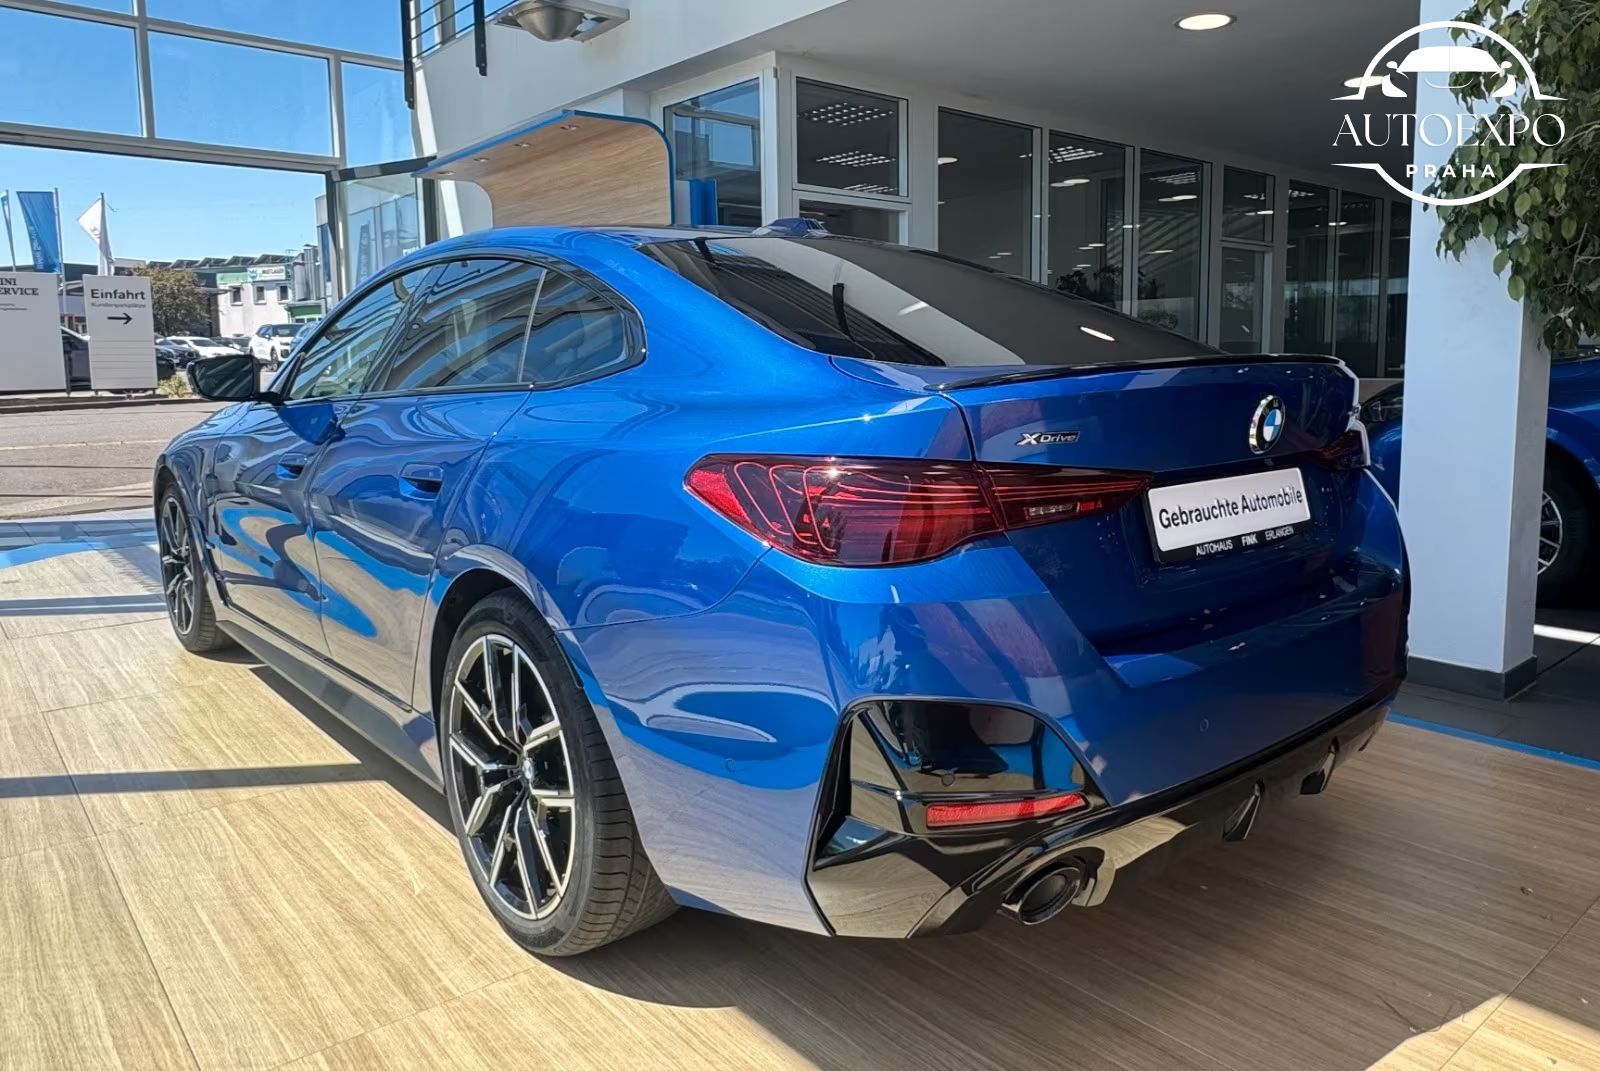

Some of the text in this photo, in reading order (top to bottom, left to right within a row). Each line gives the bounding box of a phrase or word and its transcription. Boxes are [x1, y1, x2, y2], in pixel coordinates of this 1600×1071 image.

[90, 288, 146, 300] Einfahrt
[1158, 486, 1303, 529] Gebrauchte Automobile
[1195, 526, 1295, 557] AUTOHAUS FINK ERLANGEN
